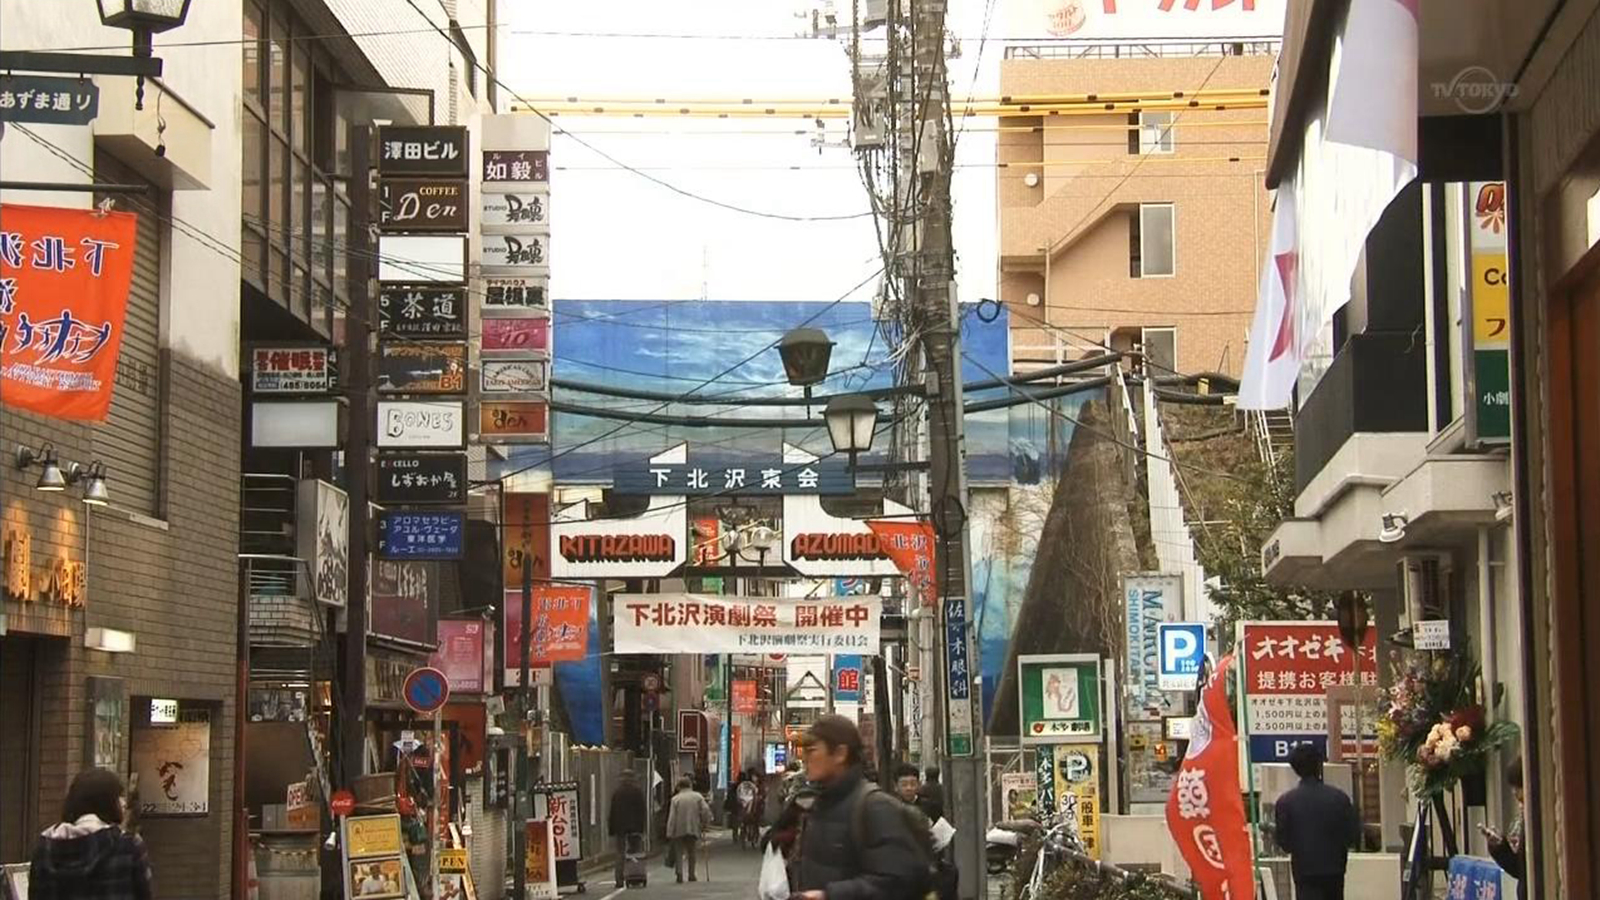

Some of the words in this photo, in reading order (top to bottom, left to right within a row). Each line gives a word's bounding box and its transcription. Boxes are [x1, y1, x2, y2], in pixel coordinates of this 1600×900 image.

[0, 89, 92, 111] あずま通り
[384, 141, 459, 160] 澤田ビル
[419, 186, 459, 196] COFFEE
[393, 192, 458, 222] Den
[401, 292, 458, 319] 茶道
[387, 408, 454, 438] BONES
[648, 467, 821, 490] 下北沢東会
[559, 533, 675, 563] KITAZAWA
[791, 533, 885, 562] AZUMAD
[626, 603, 777, 627] 下北沢演劇祭
[795, 604, 869, 628] 開催中
[948, 603, 968, 697] 佐々木眼科
[1164, 630, 1197, 672] P
[1252, 634, 1345, 663] オオゼキ
[549, 792, 571, 858] 新台北
